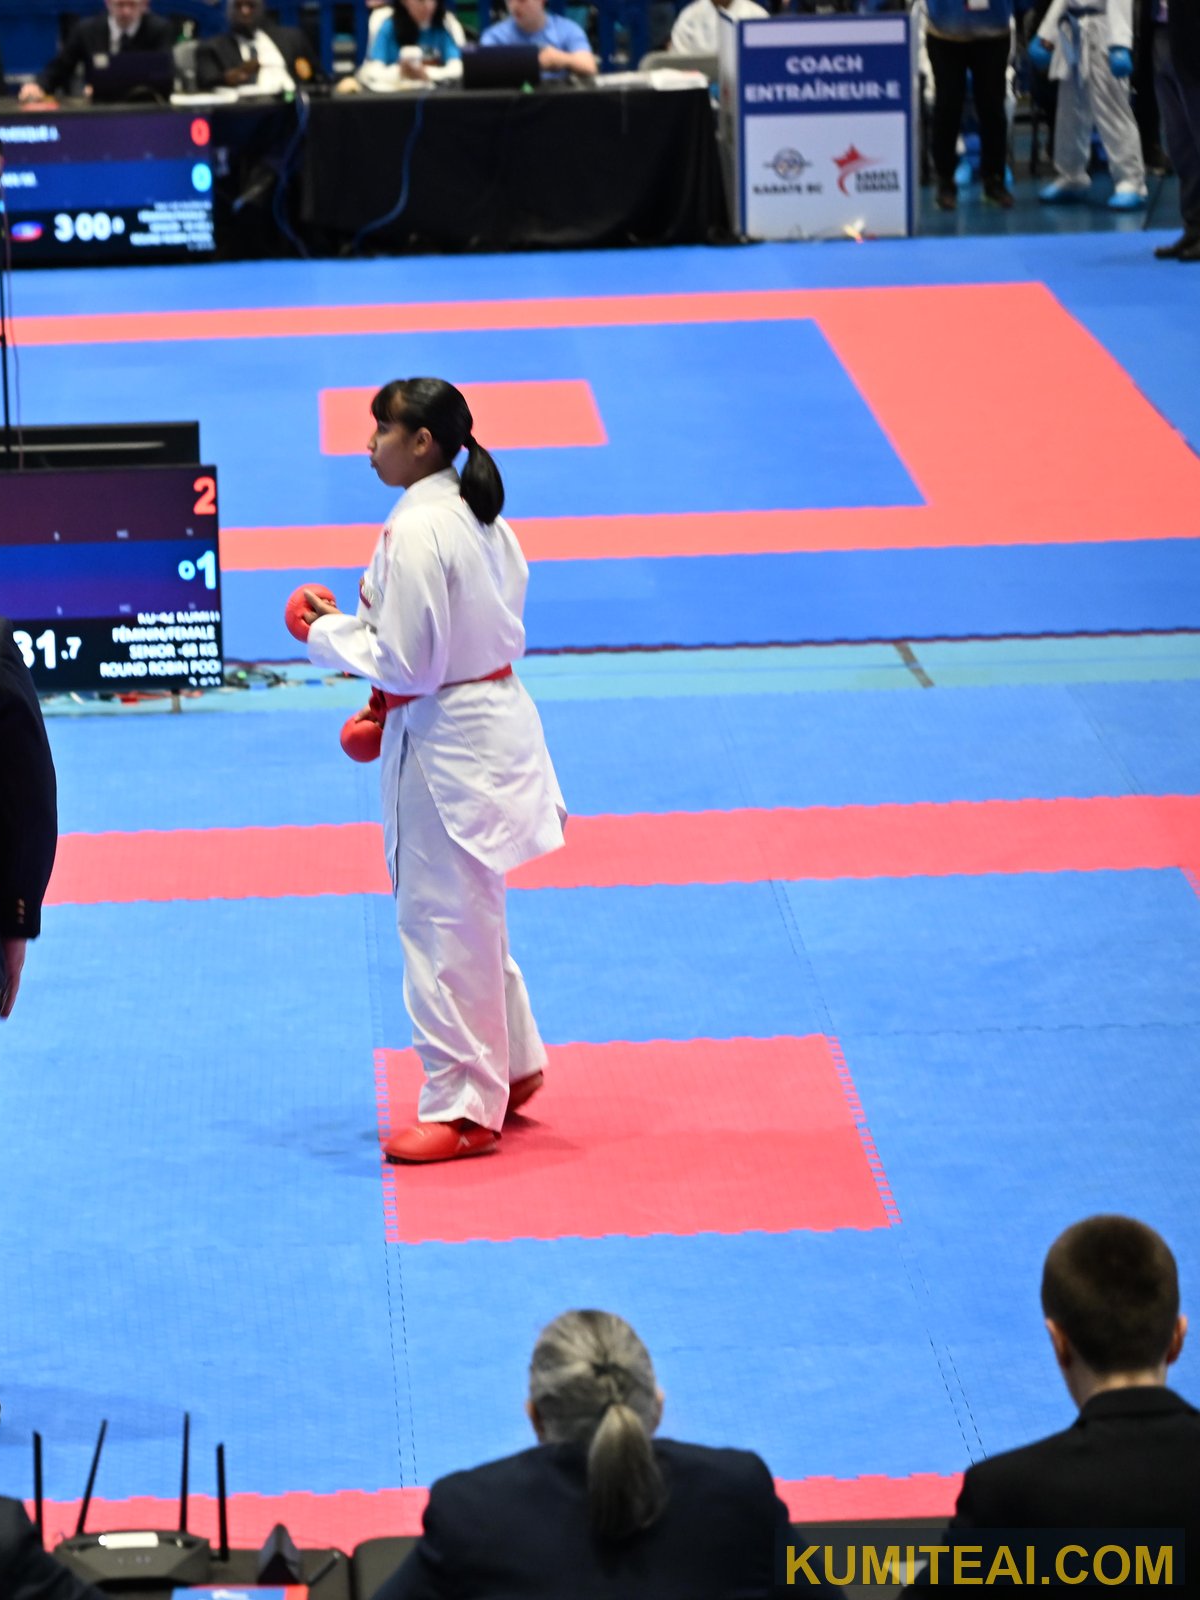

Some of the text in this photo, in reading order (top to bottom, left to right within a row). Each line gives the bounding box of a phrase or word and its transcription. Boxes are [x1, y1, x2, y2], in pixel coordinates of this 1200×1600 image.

[785, 55, 863, 74] COACH
[191, 117, 210, 146] 0
[193, 476, 216, 515] 2
